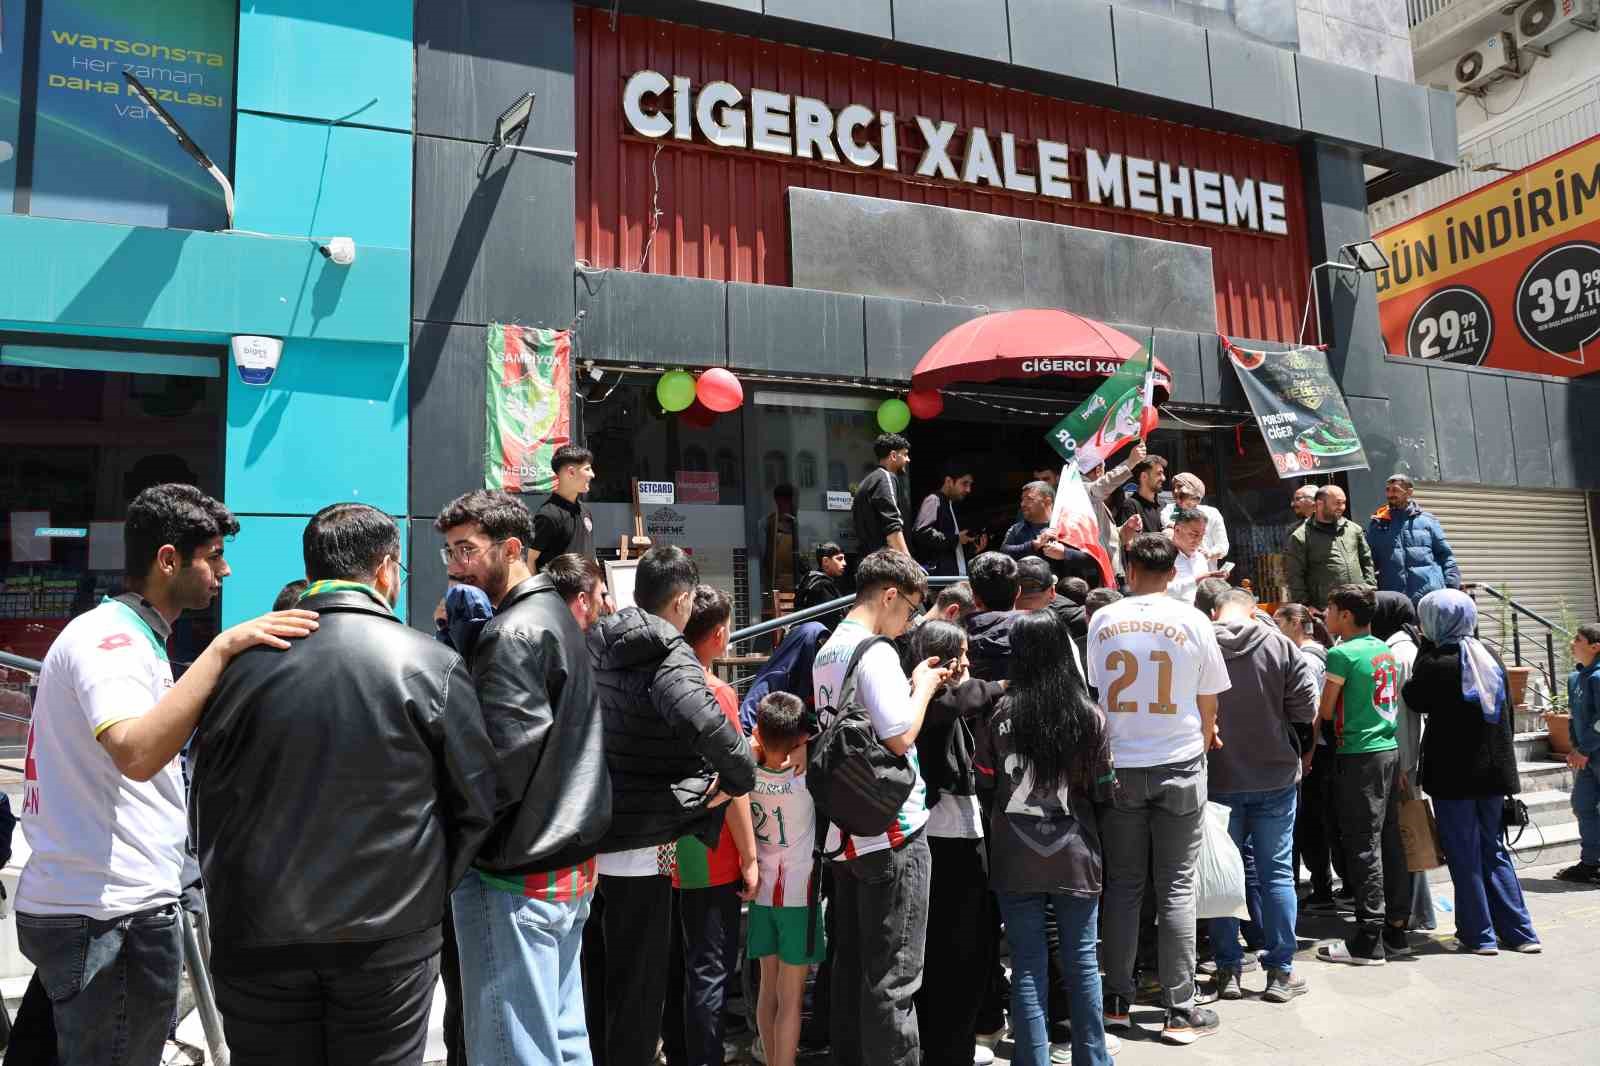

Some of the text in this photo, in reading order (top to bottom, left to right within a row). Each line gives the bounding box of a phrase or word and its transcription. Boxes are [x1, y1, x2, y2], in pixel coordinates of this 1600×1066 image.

[72, 56, 118, 73] Her
[914, 114, 1073, 199] XALE
[1084, 148, 1288, 236] MEHEME
[1021, 358, 1091, 372] CİĞERCİ
[639, 483, 673, 494] SETCARD
[1098, 621, 1188, 647] AMEDSPOR
[1104, 650, 1178, 714] 21
[751, 801, 788, 848] 21
